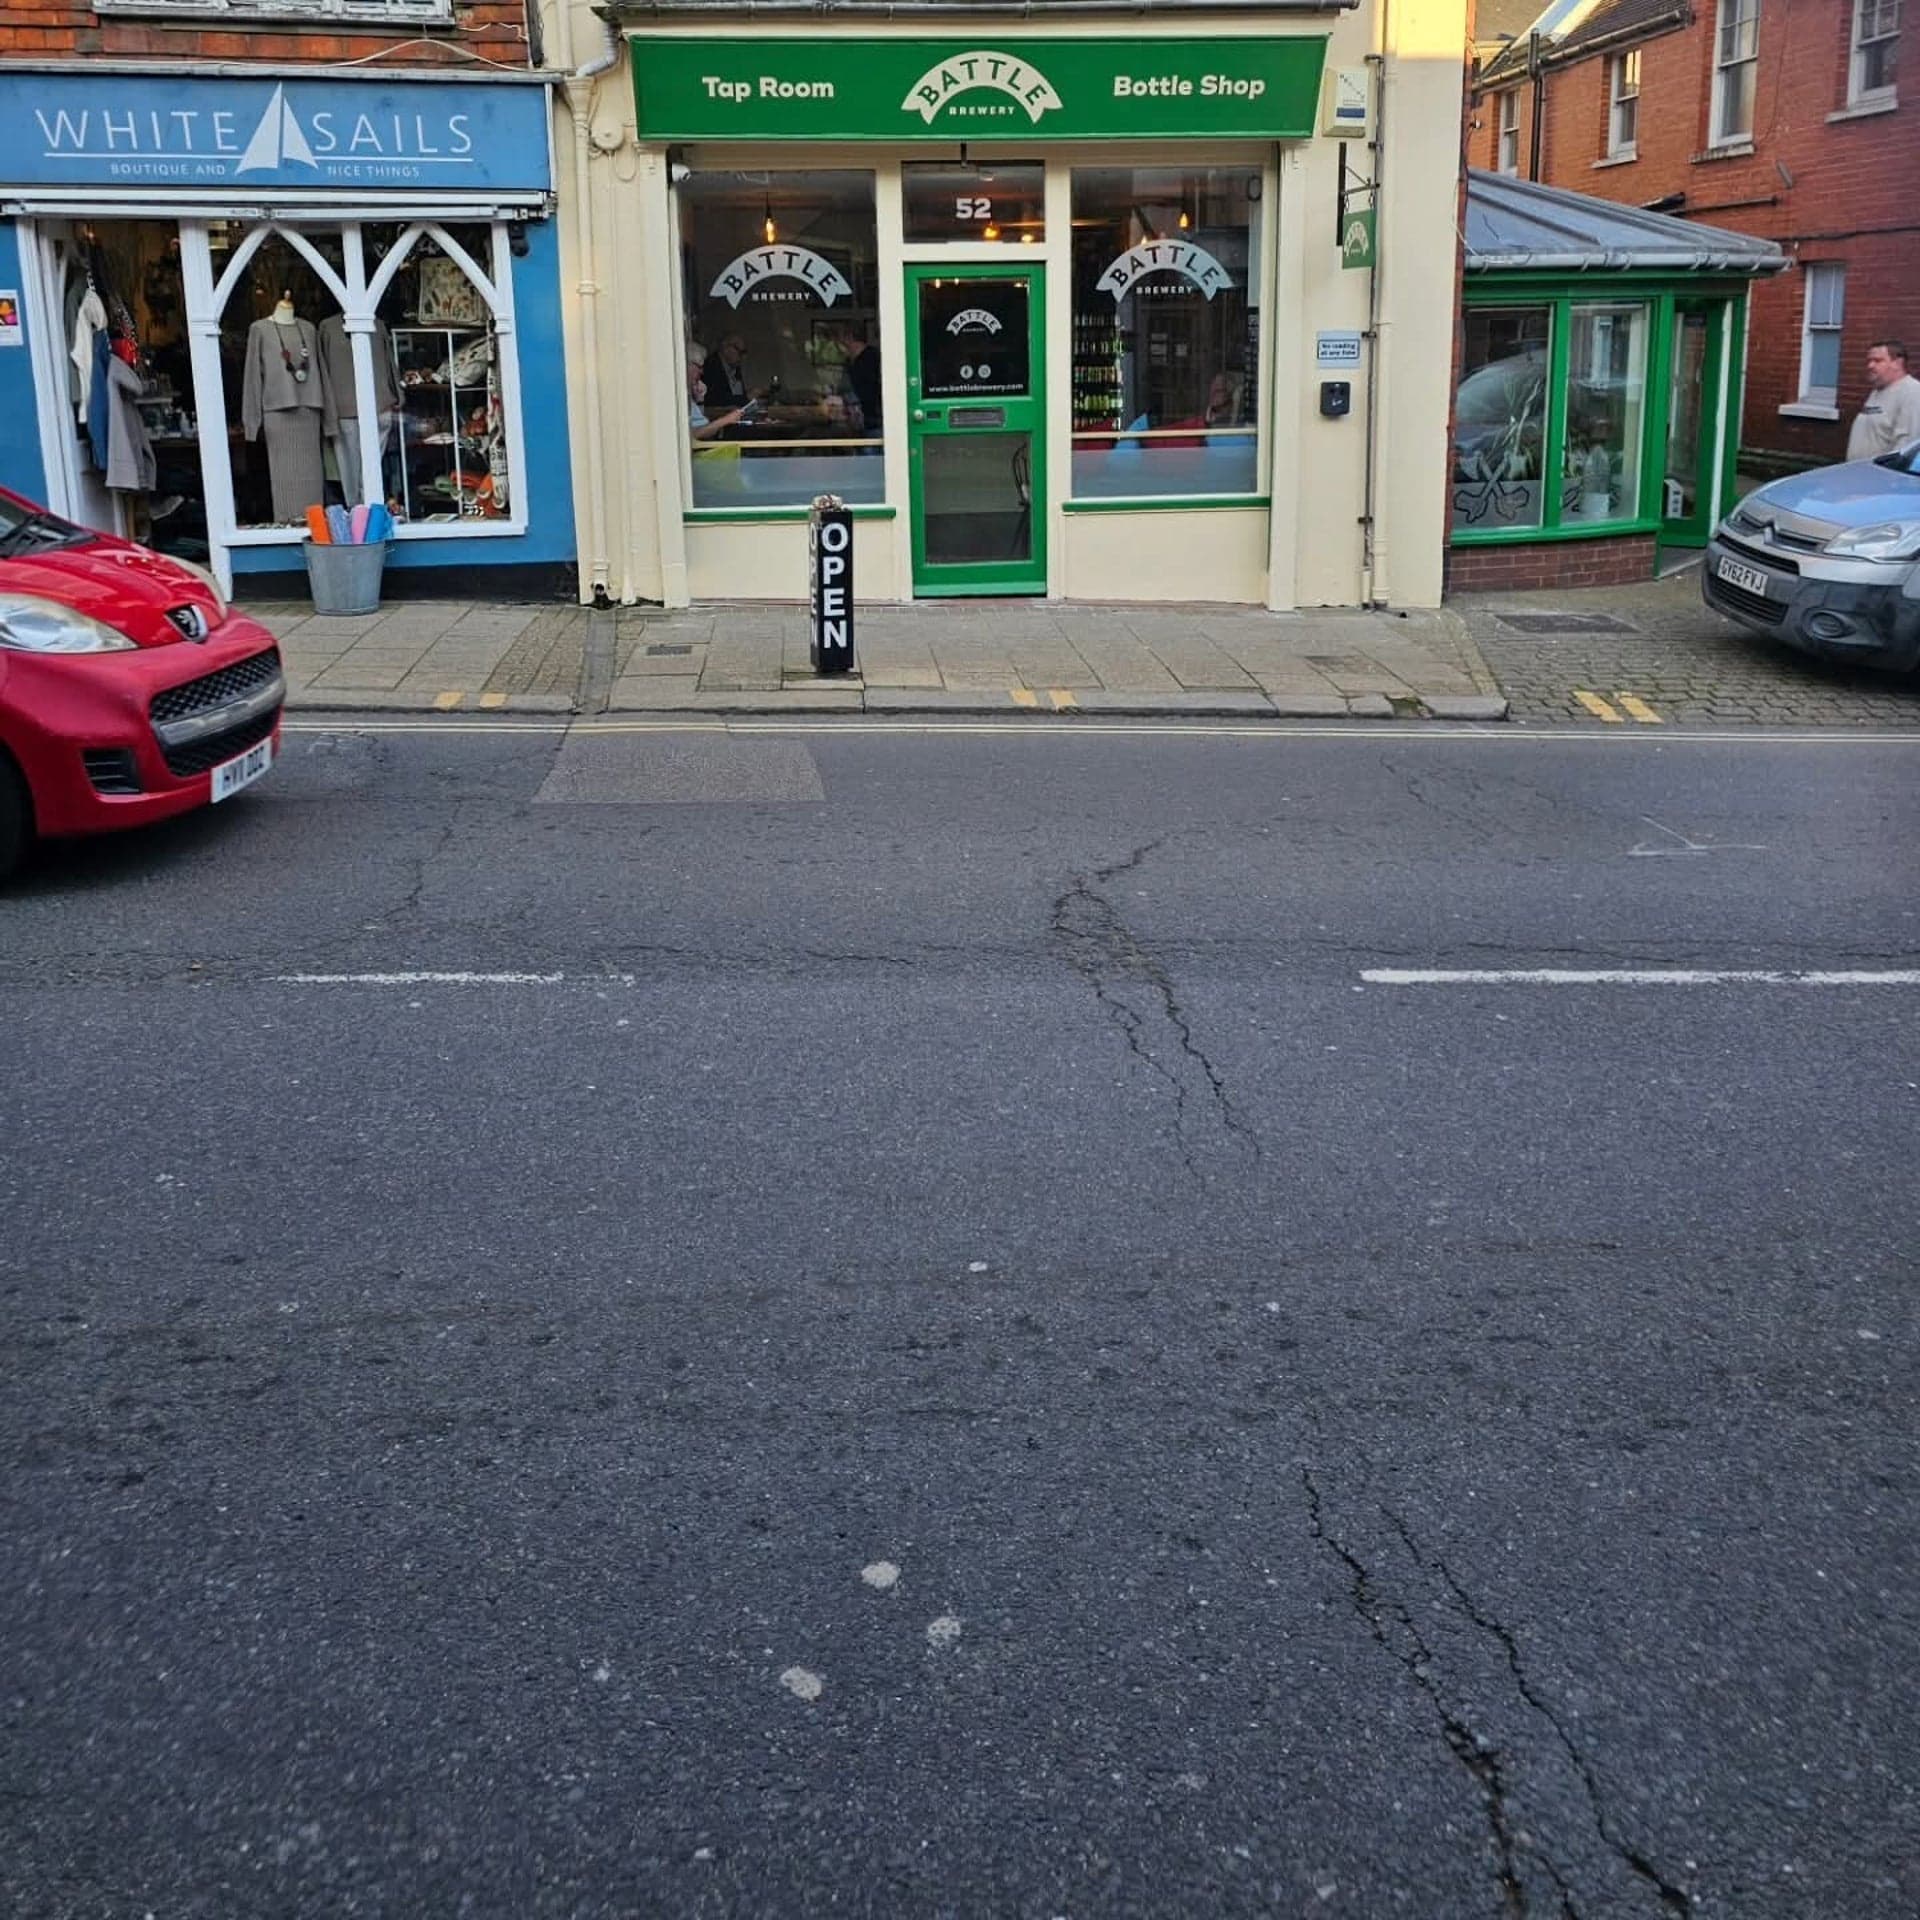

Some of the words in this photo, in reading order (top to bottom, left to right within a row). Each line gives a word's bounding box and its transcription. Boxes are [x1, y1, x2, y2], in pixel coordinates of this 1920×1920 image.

[702, 76, 752, 103] Tap
[759, 76, 834, 98] Room
[917, 58, 1047, 107] BATTLE
[1114, 75, 1193, 96] Bottle
[1200, 74, 1265, 99] Shop
[949, 106, 1015, 116] BREWERY
[35, 109, 239, 150] WHITE
[312, 112, 471, 153] SAILS
[110, 163, 190, 175] BOUTIQUE
[195, 165, 225, 176] AND
[327, 165, 361, 177] NICE
[366, 166, 420, 178] THINGS
[955, 197, 992, 219] 52
[723, 251, 838, 294] BATTLE
[1109, 245, 1219, 287] BATTLE
[752, 292, 811, 300] BREWERY
[1136, 286, 1193, 295] BREWERY
[821, 522, 849, 649] OPEN
